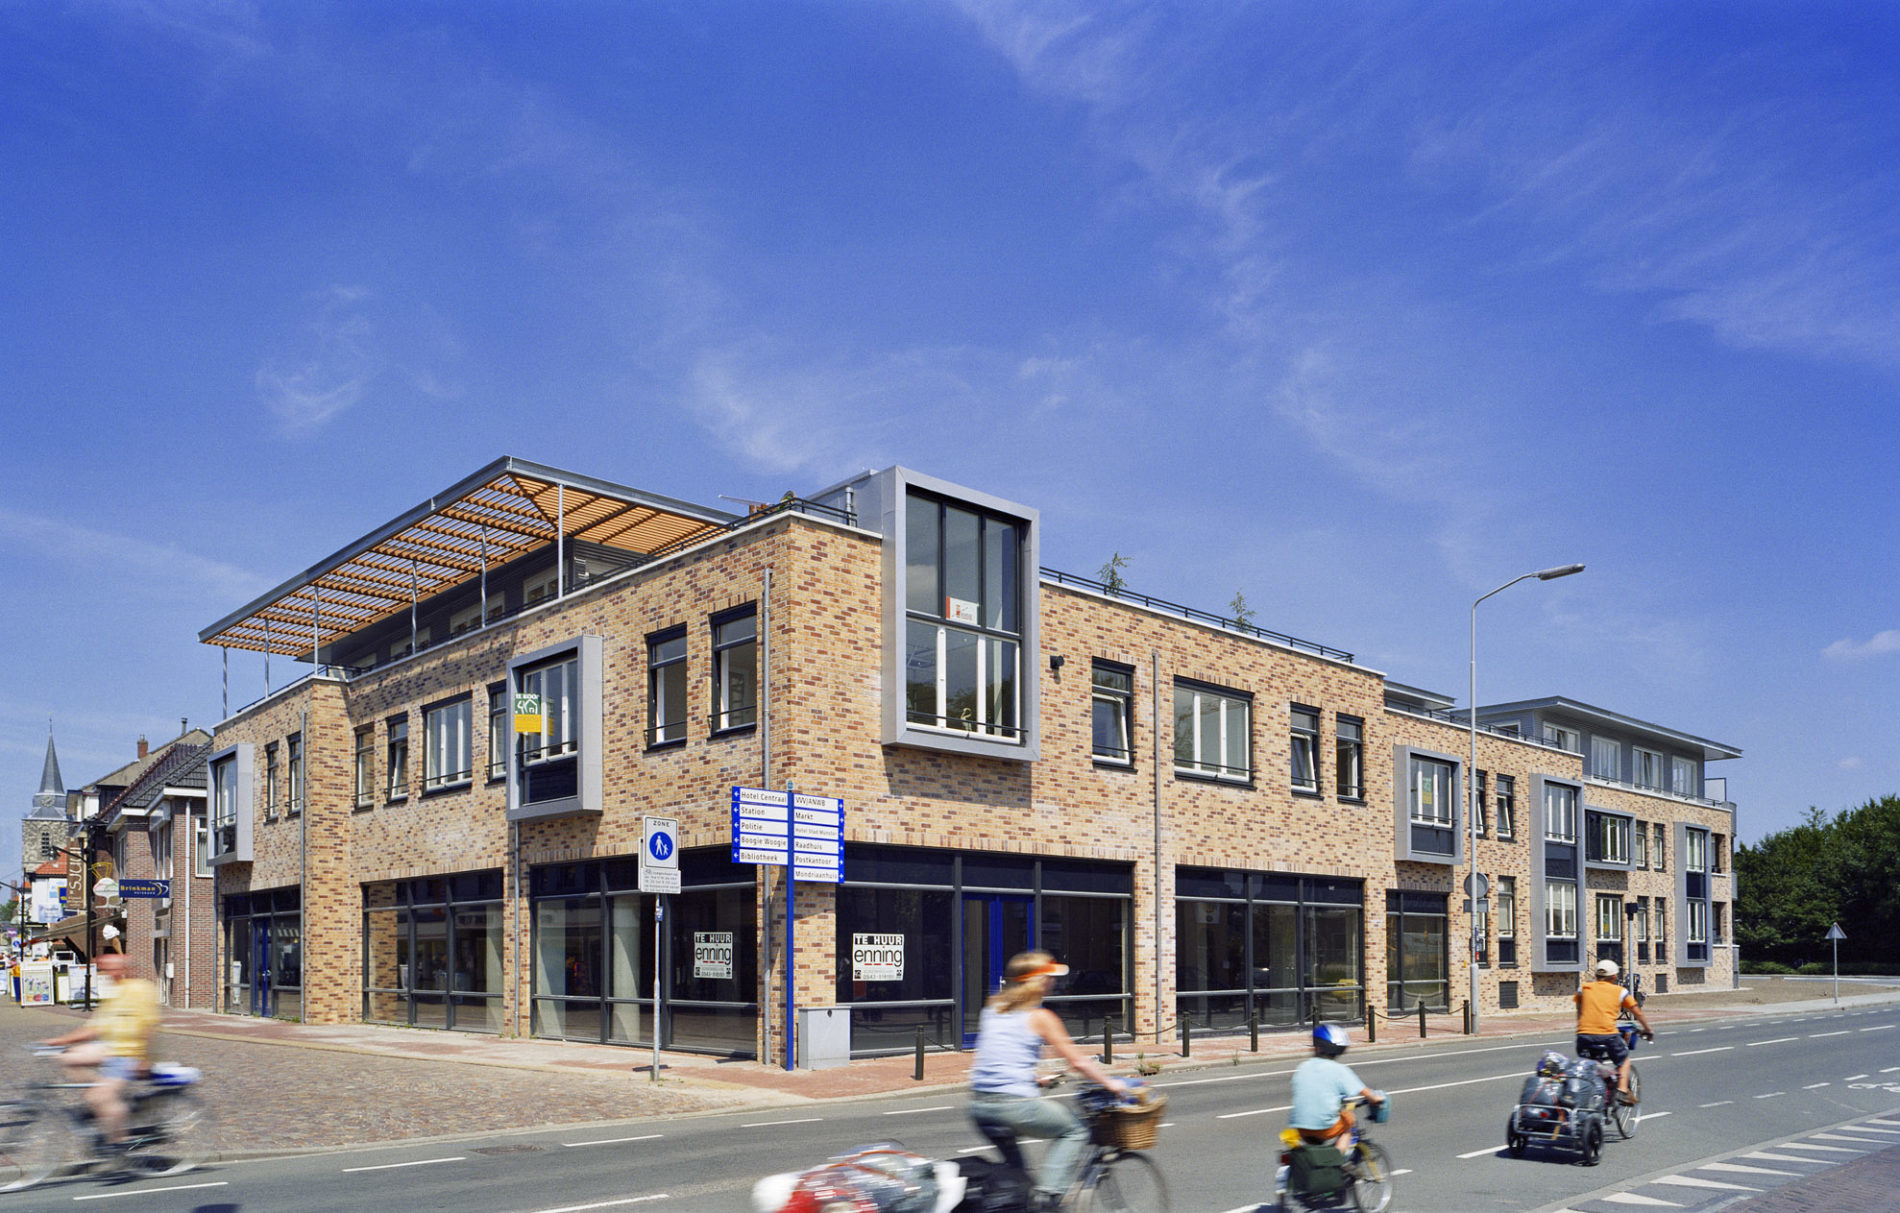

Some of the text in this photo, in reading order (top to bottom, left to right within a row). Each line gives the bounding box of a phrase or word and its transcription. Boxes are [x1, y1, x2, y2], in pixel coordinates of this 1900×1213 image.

[741, 791, 787, 802] Hotel Centraal
[741, 806, 765, 815] Station
[795, 812, 814, 820] Markt
[741, 822, 763, 831] Politie
[741, 836, 787, 848] Boogie Woogie
[795, 841, 823, 850] Raadhuis
[741, 852, 778, 862] Bibliotheek
[795, 855, 832, 865] Postkantoor
[696, 934, 731, 943] TE HUUR
[856, 935, 902, 945] TE HUUR
[695, 943, 731, 966] enning
[854, 945, 903, 967] enning
